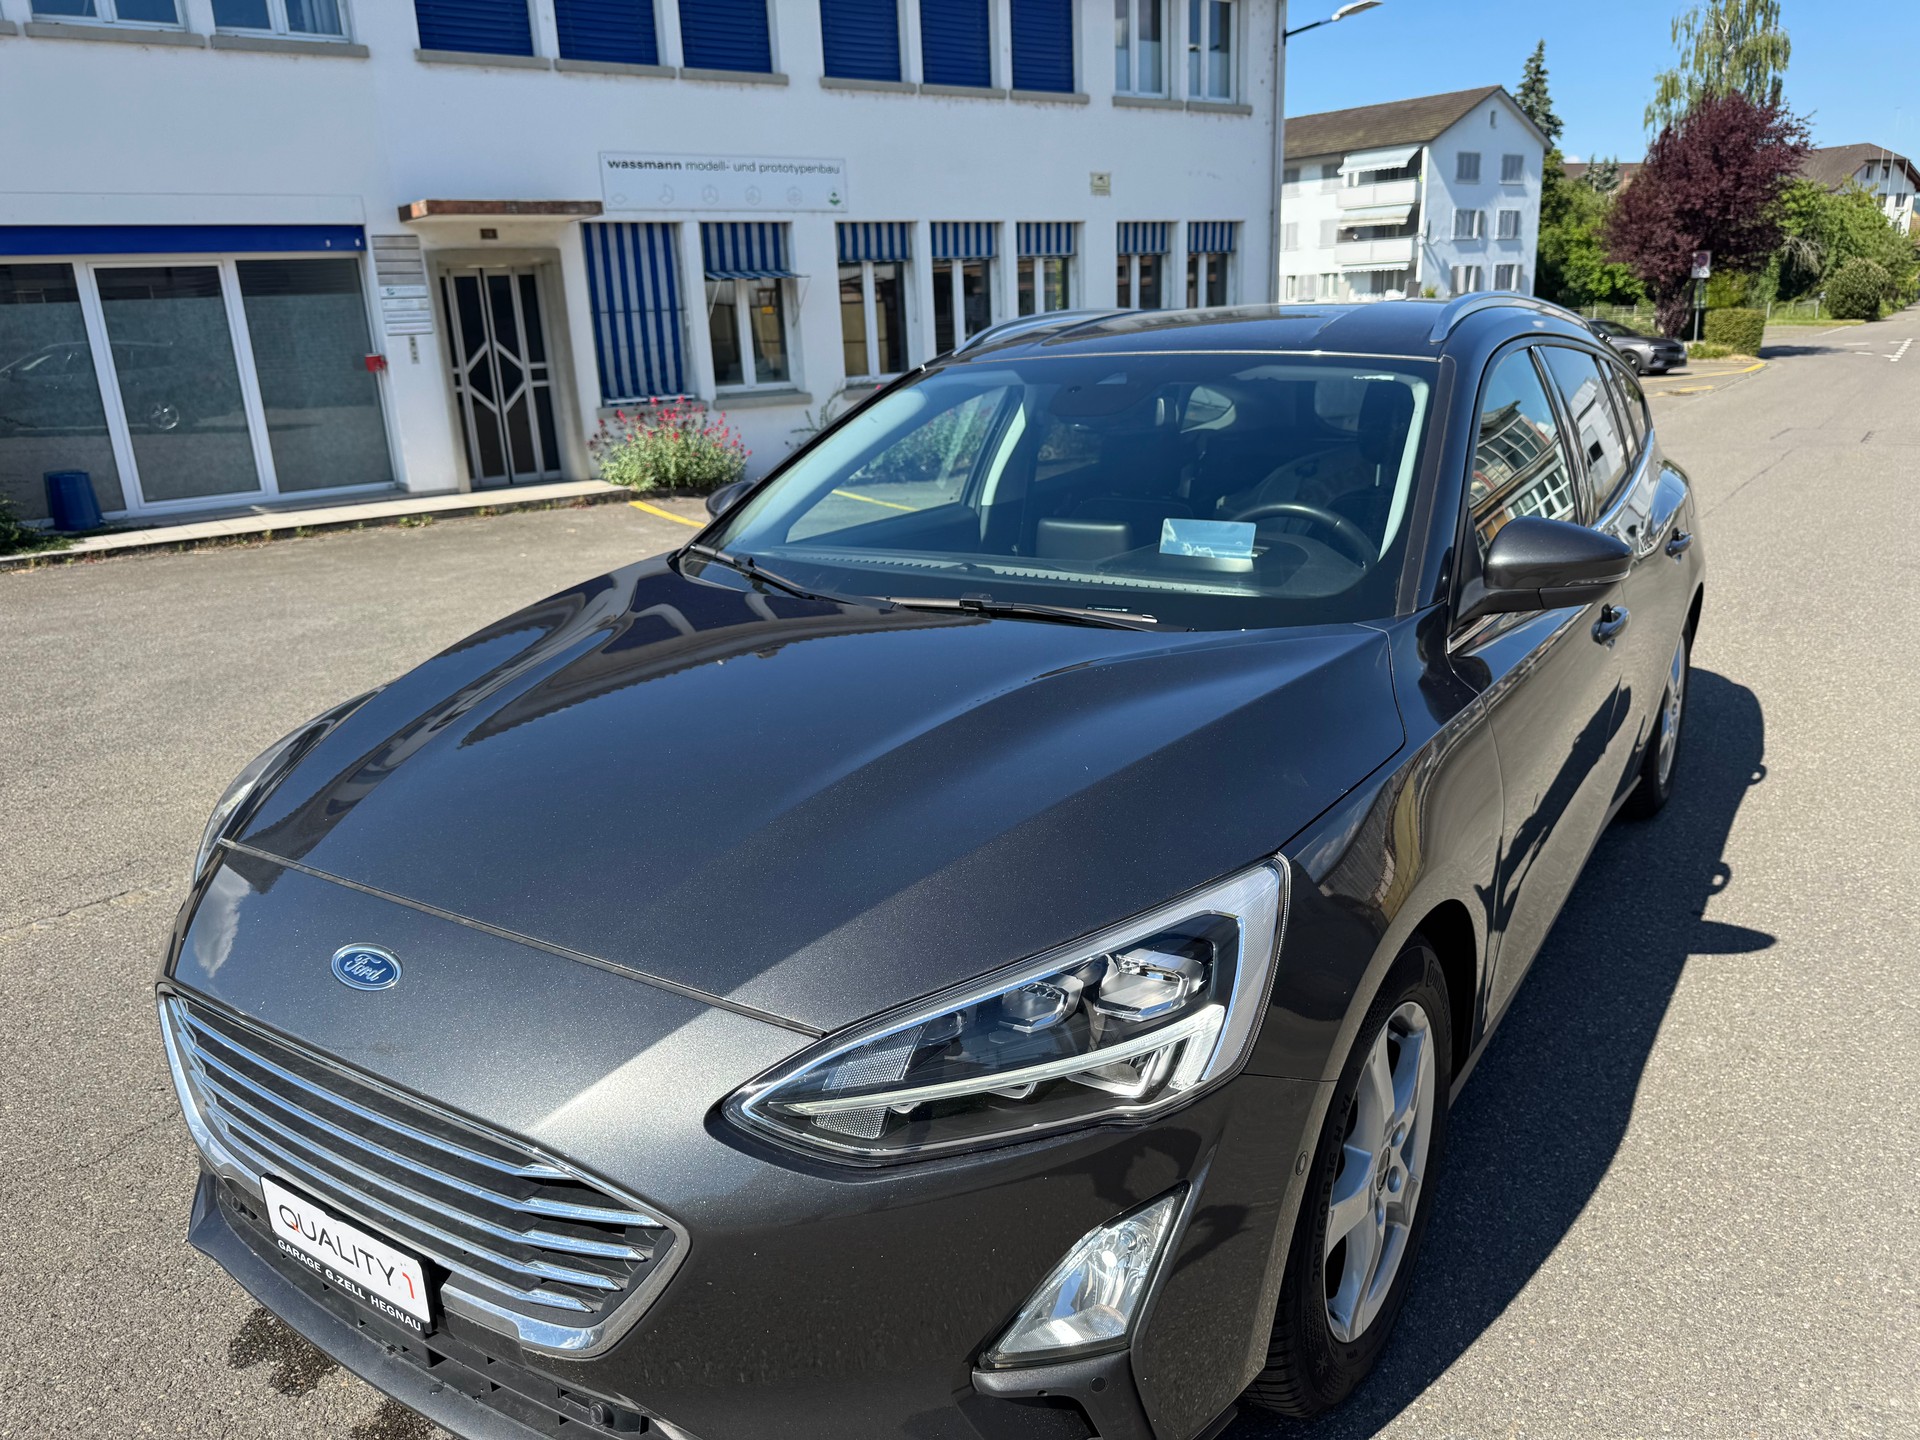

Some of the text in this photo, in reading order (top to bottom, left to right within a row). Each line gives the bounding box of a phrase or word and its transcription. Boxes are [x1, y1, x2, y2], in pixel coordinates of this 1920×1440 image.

[607, 160, 682, 170] wassmann
[733, 161, 756, 172] und
[758, 163, 840, 175] prototypenbau
[344, 954, 387, 981] Ford
[277, 1239, 422, 1332] GARAGE G.ZELL HEGNAU
